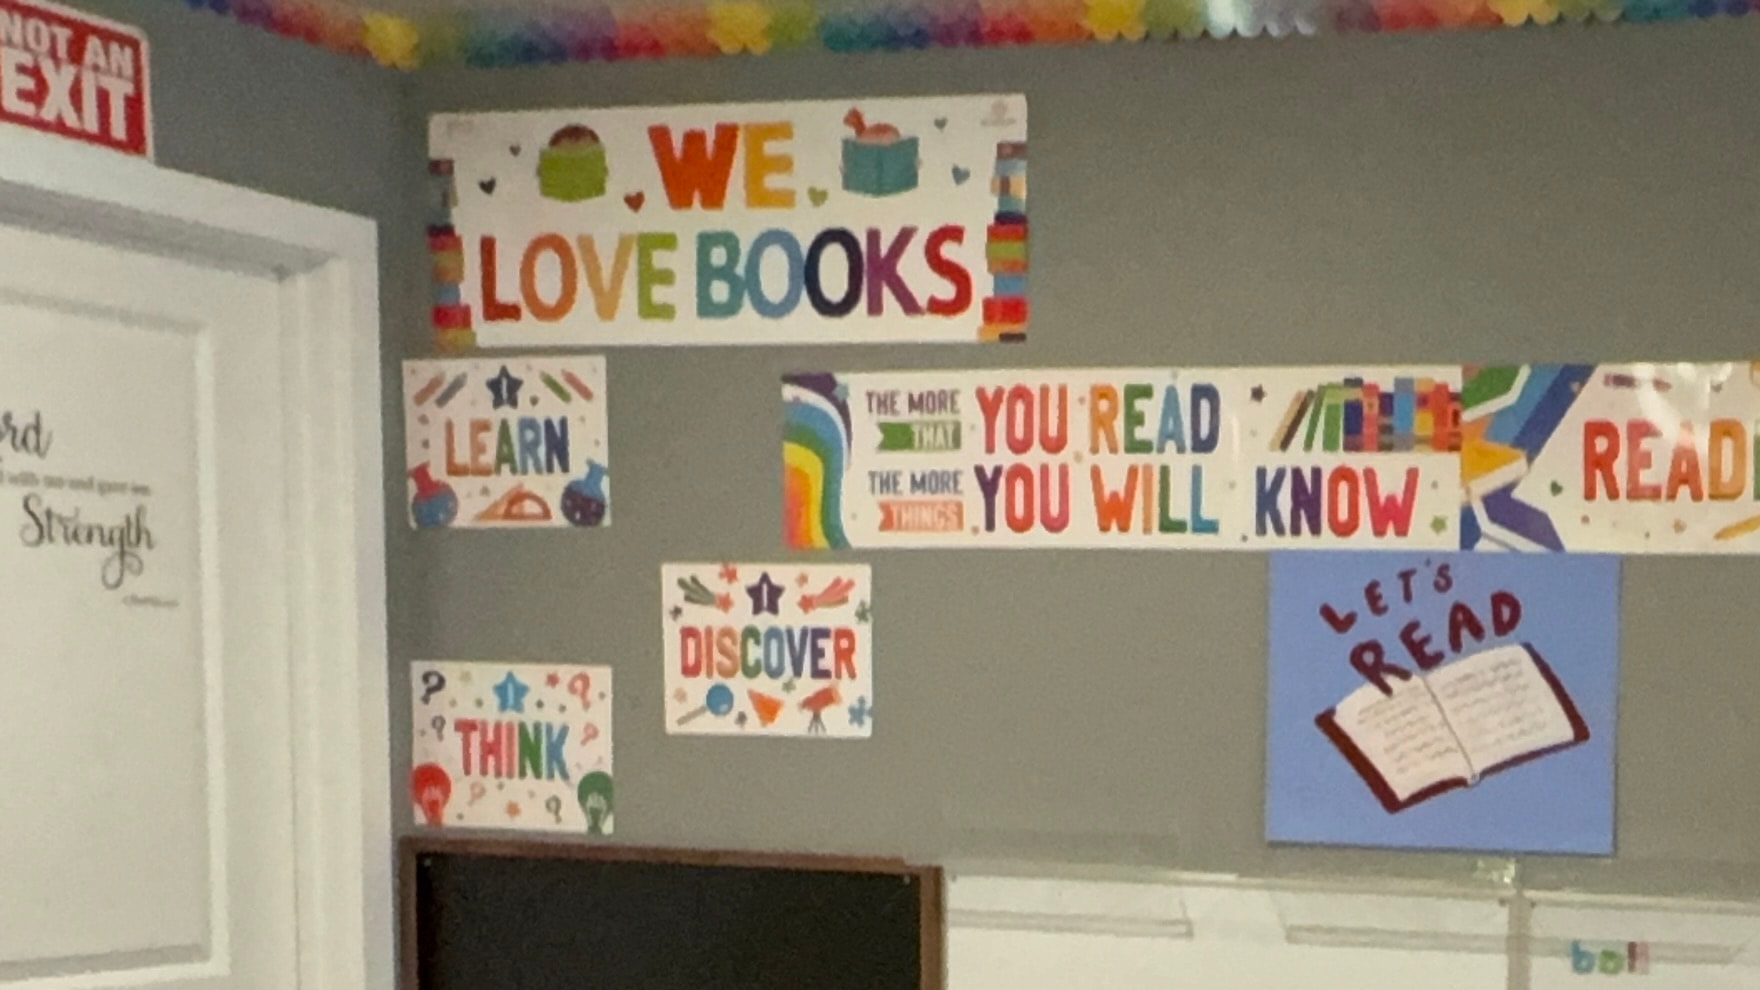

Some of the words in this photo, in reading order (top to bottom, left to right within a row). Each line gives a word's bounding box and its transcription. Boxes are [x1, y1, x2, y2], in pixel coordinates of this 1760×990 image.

[0, 8, 73, 60] NOT
[83, 33, 135, 79] AN
[1, 48, 135, 141] EXIT
[647, 121, 797, 211] WE
[479, 231, 678, 322] LOVE
[695, 225, 974, 320] BOOKS
[0, 409, 53, 459] rd
[866, 390, 900, 416] THE
[908, 388, 961, 415] MORE
[914, 421, 956, 450] THAT
[974, 383, 1068, 454] YOU
[1088, 383, 1221, 454] READ
[445, 416, 570, 477] LEARN
[867, 470, 903, 496] THE
[910, 469, 963, 495] MORE
[894, 502, 959, 531] THINGS
[974, 464, 1070, 534] YOU
[1090, 464, 1220, 535] WILL
[1255, 464, 1420, 537] KNOW
[19, 492, 157, 591] Strength
[1319, 557, 1454, 634] LET'S
[679, 626, 857, 680] DISCOVER
[1349, 590, 1522, 698] READ
[454, 718, 570, 781] THINK
